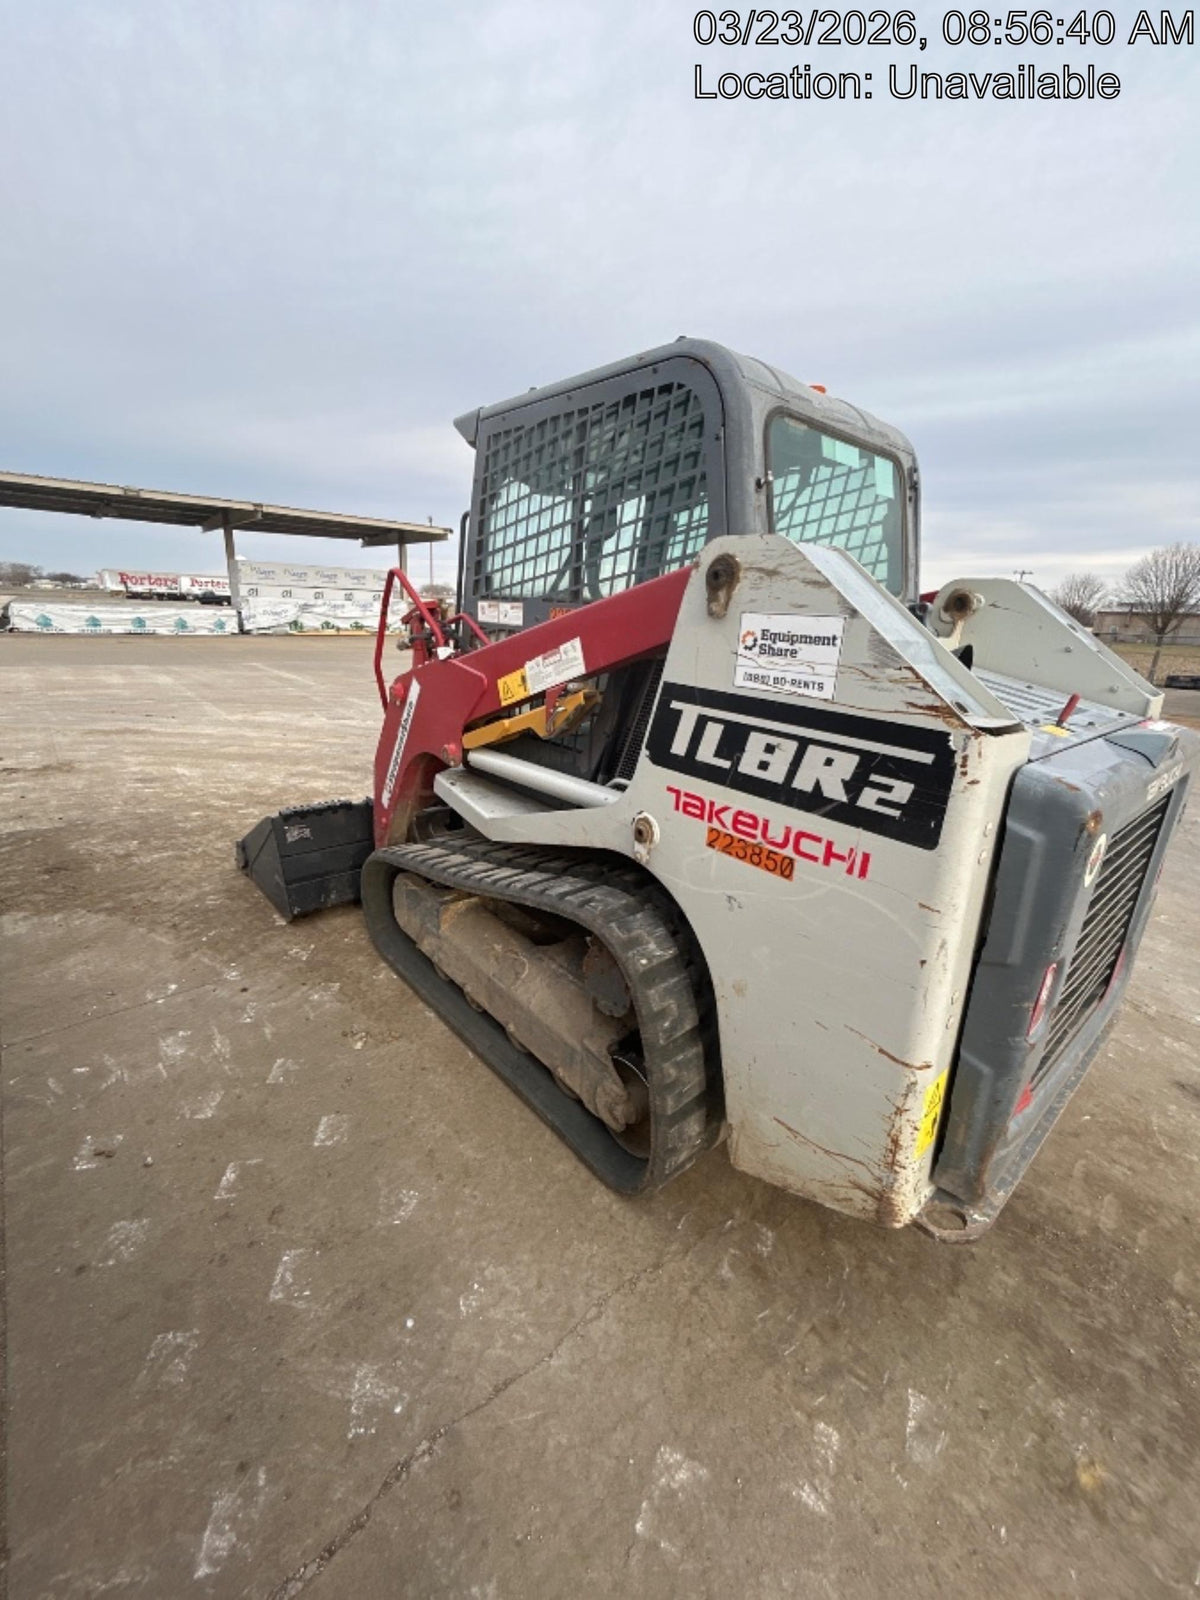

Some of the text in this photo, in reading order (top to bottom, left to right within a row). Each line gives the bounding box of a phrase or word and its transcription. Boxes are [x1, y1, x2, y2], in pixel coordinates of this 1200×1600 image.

[118, 572, 179, 586] Porters
[760, 629, 838, 647] Equipment
[758, 643, 798, 659] Share
[669, 700, 937, 817] TL8R2
[707, 828, 794, 878] 223850
